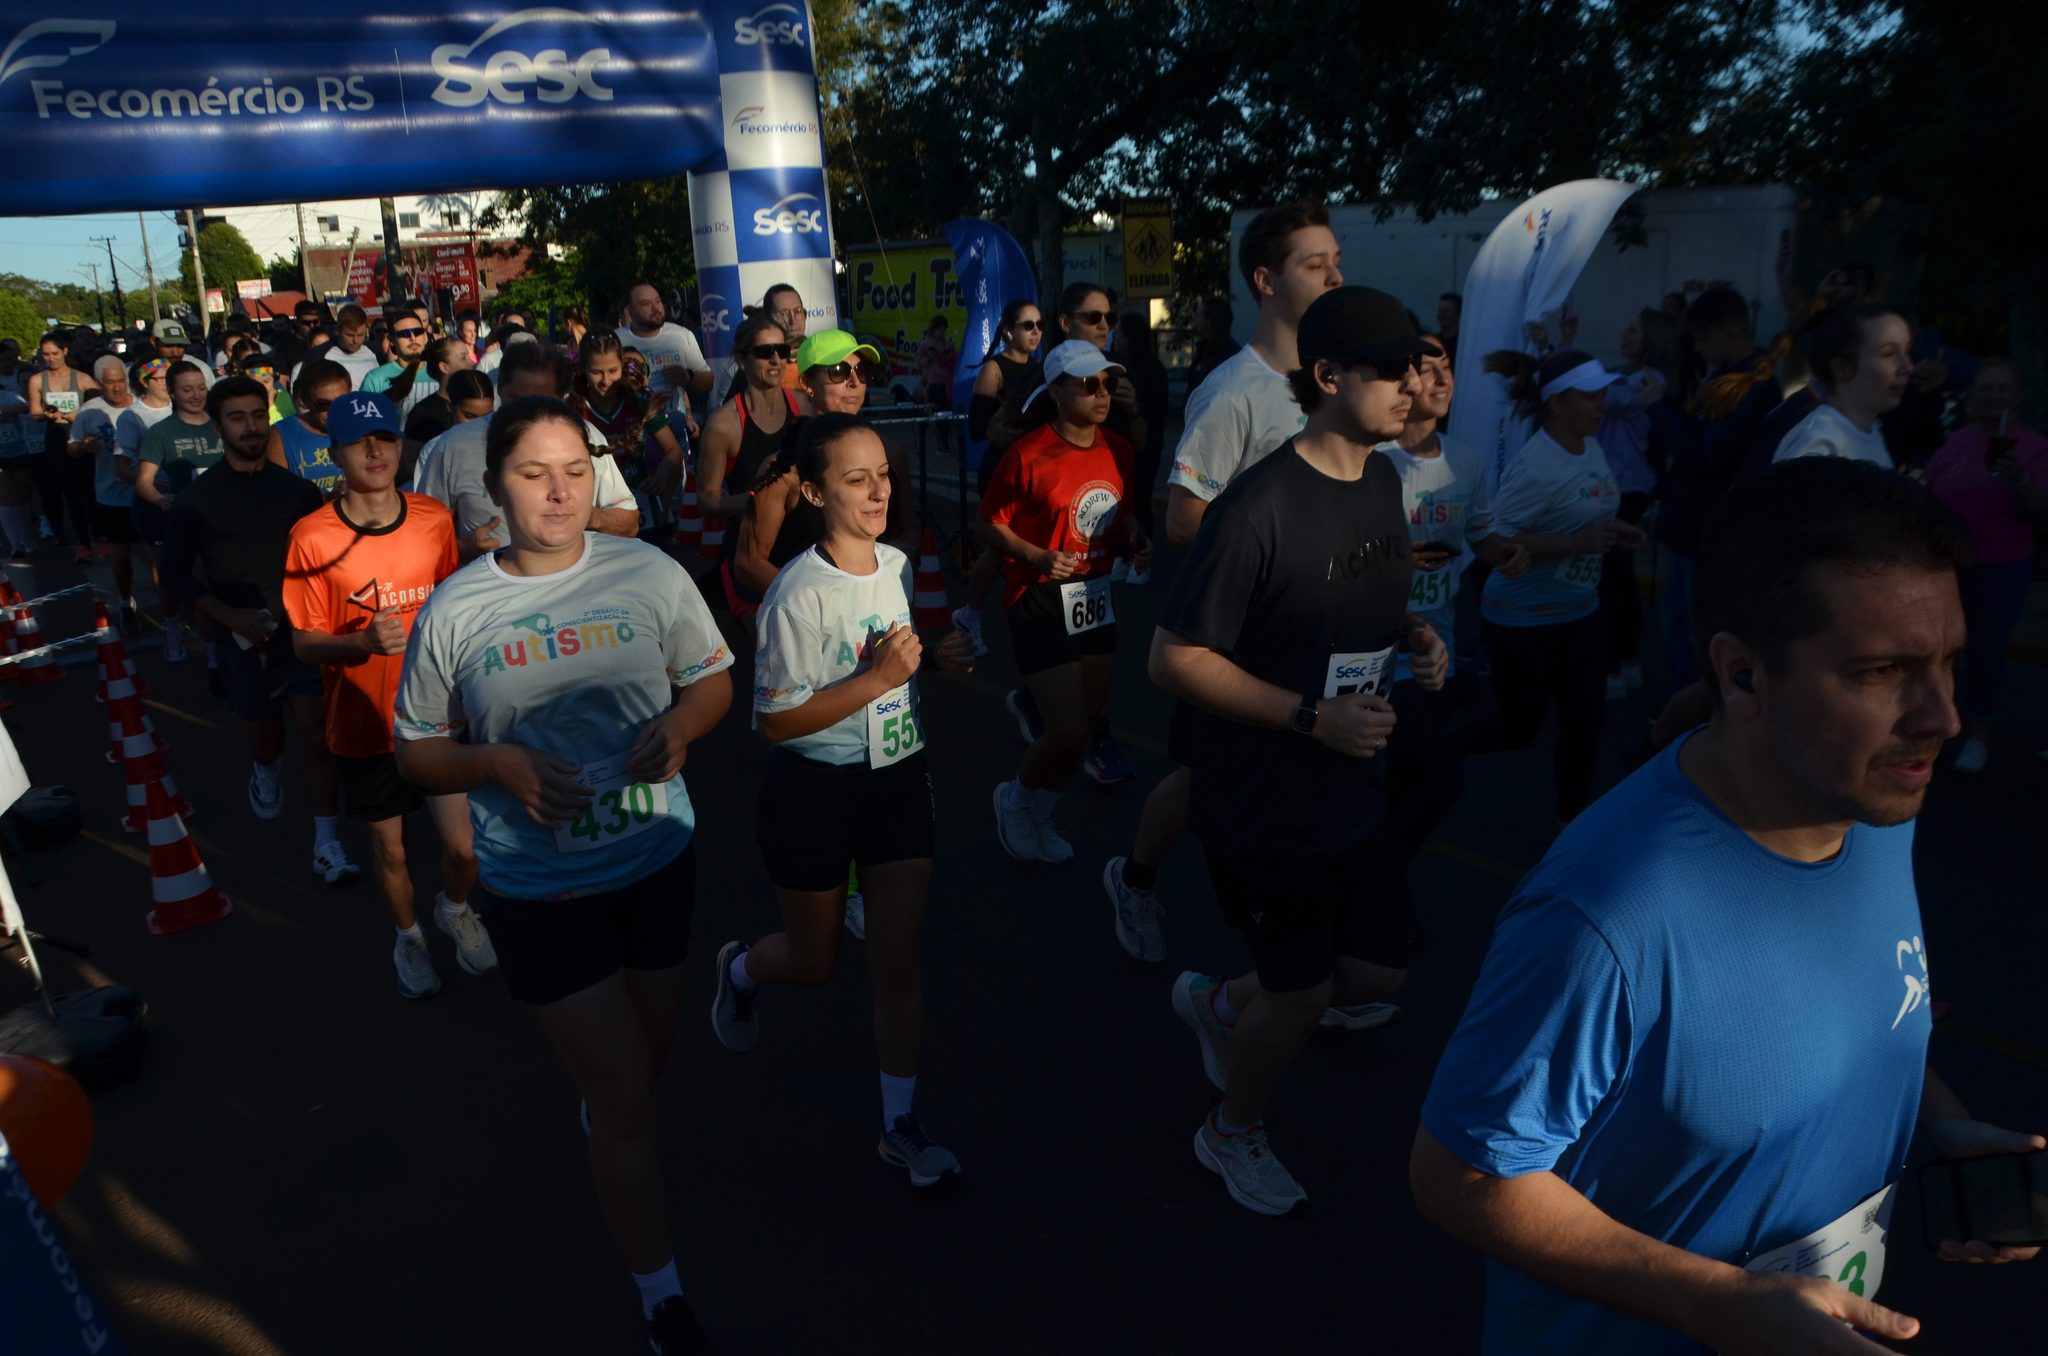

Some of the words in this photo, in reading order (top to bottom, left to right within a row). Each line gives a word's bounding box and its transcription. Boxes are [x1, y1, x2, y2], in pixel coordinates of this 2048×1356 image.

[734, 16, 804, 47] Sesc
[430, 42, 614, 107] Sesc
[30, 76, 304, 119] Fecomércio
[316, 75, 375, 113] RS
[739, 121, 806, 135] Fecomércio
[753, 207, 822, 236] Sesc
[856, 261, 916, 311] Food
[930, 259, 966, 308] Tru
[1129, 273, 1170, 288] ELEVADA
[52, 400, 76, 410] 446
[350, 399, 383, 419] LA
[1410, 571, 1450, 606] 451
[1072, 594, 1107, 629] 686
[484, 621, 636, 677] Autismo
[1336, 666, 1368, 679] Sesc
[876, 699, 902, 715] Sesc
[571, 779, 654, 842] 430
